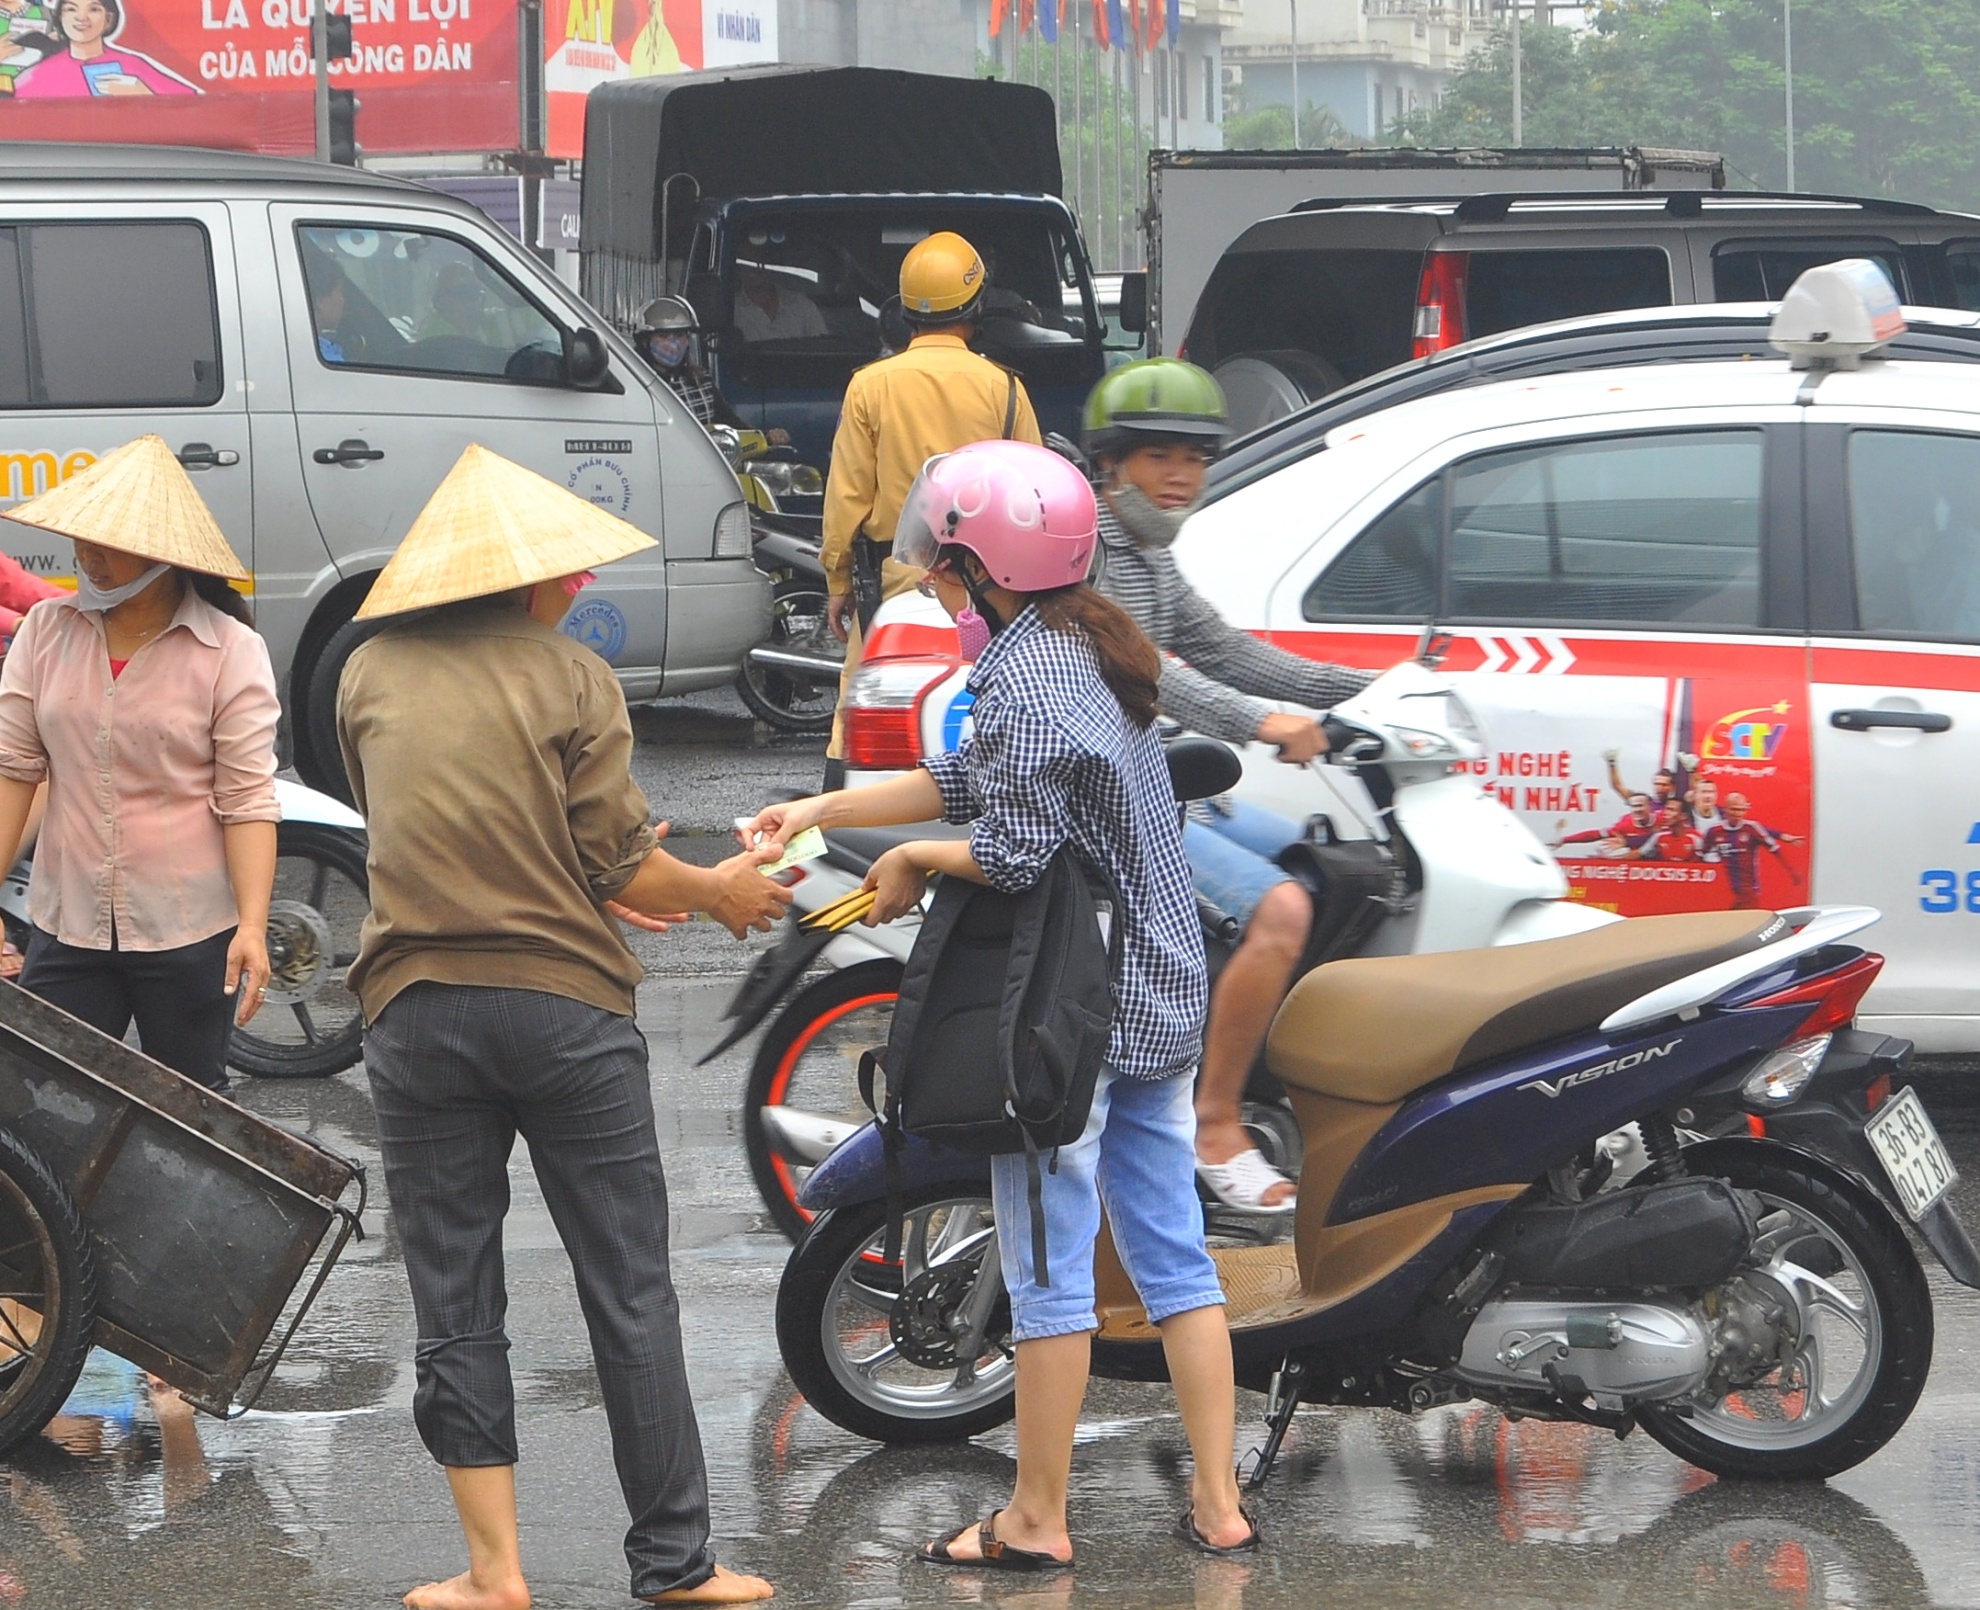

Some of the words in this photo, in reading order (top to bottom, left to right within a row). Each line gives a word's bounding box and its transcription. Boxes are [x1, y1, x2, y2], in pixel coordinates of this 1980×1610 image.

[200, 41, 257, 80] CỦA
[413, 37, 472, 72] DÂN
[1709, 722, 1788, 759] SCTV
[1498, 750, 1571, 780] NGHỆ
[1898, 1139, 1951, 1211] 047.87
